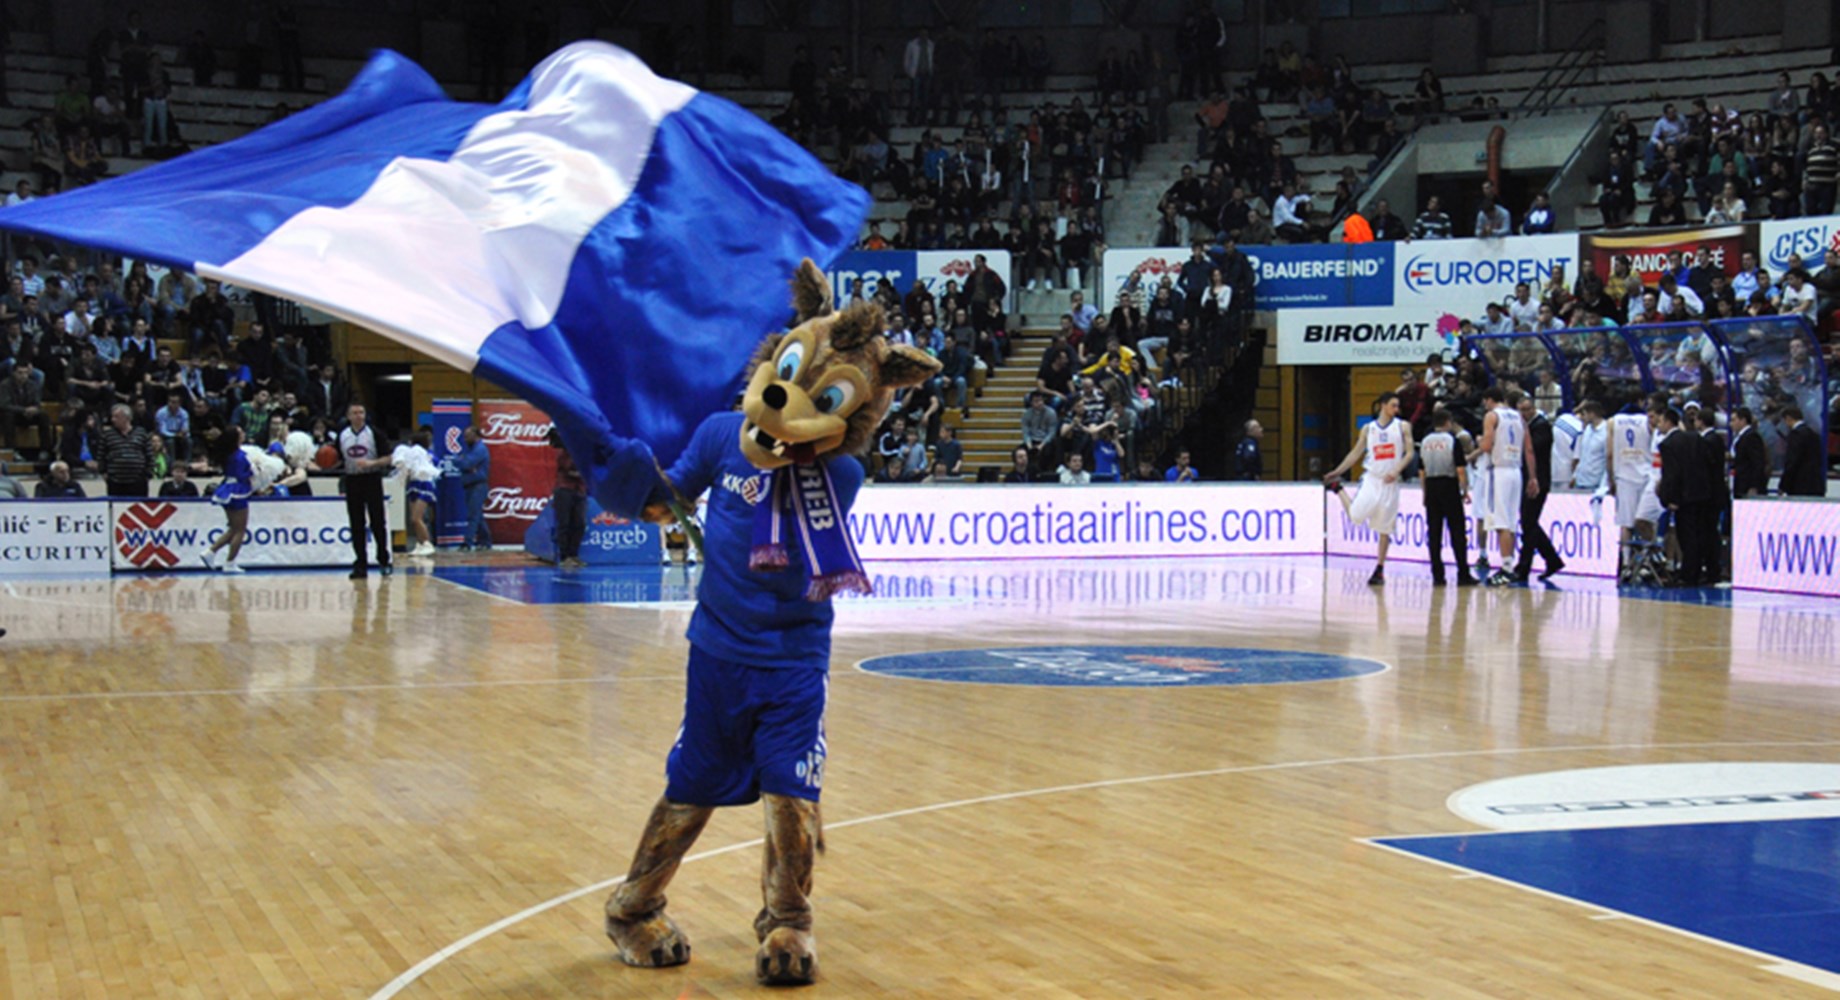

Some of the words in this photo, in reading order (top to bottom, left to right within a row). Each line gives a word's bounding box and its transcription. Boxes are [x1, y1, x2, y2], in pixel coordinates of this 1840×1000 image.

[1262, 259, 1379, 280] BAUERFEIND
[1411, 257, 1571, 286] EURORENT
[1303, 323, 1429, 343] BIROMAT
[481, 413, 556, 437] Franc
[483, 487, 553, 512] Franc
[800, 464, 834, 531] REB
[0, 515, 30, 534] lić
[56, 515, 104, 534] Erić
[847, 502, 1296, 545] www.croatiaairlines.com
[582, 524, 648, 550] agreb
[0, 545, 108, 561] CURITY
